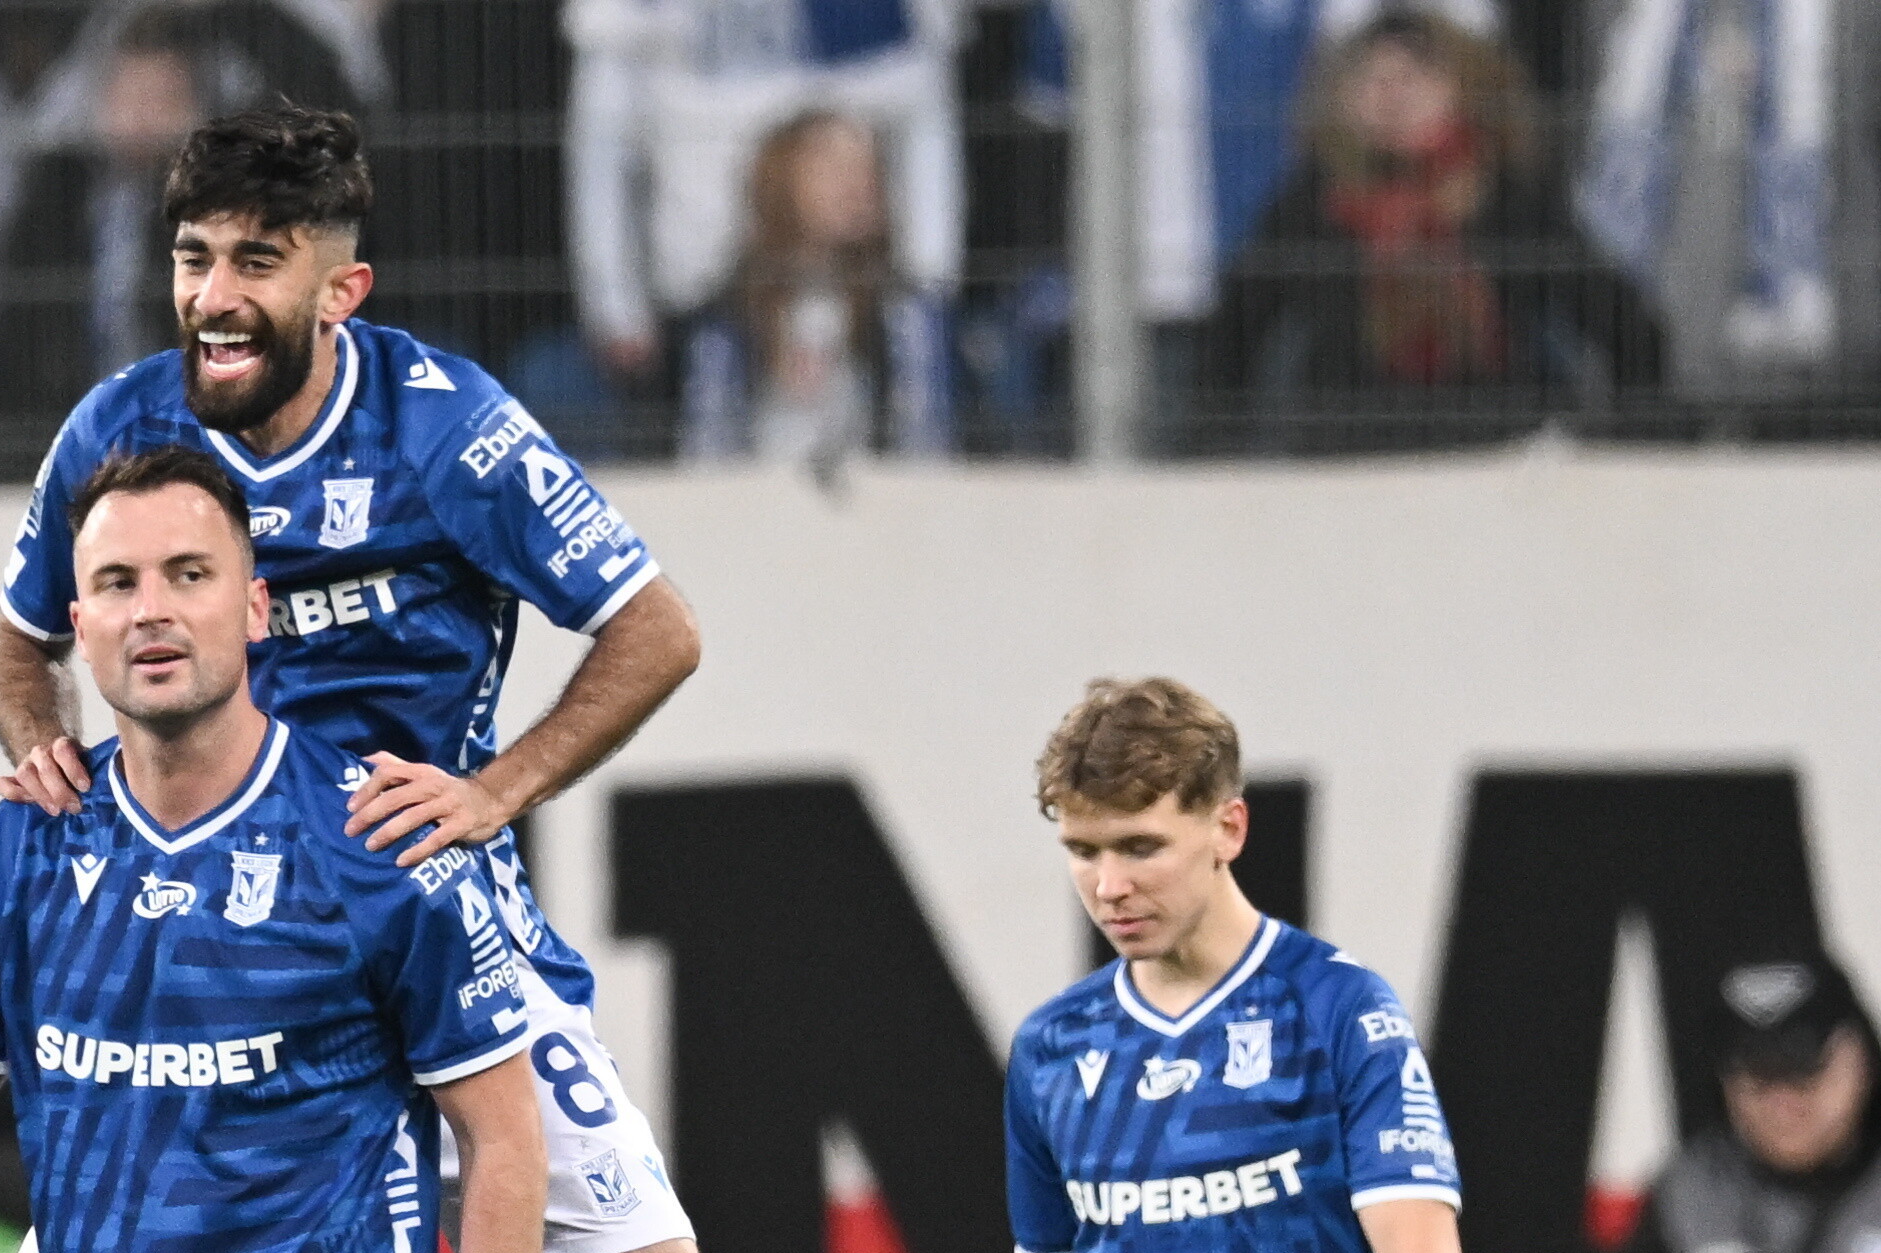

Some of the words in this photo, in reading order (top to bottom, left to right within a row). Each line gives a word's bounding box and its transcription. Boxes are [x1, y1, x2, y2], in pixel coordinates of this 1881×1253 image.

[267, 567, 397, 637] RBET
[35, 1024, 285, 1087] SUPERBET
[530, 1031, 618, 1129] 8
[1066, 1148, 1304, 1226] SUPERBET
